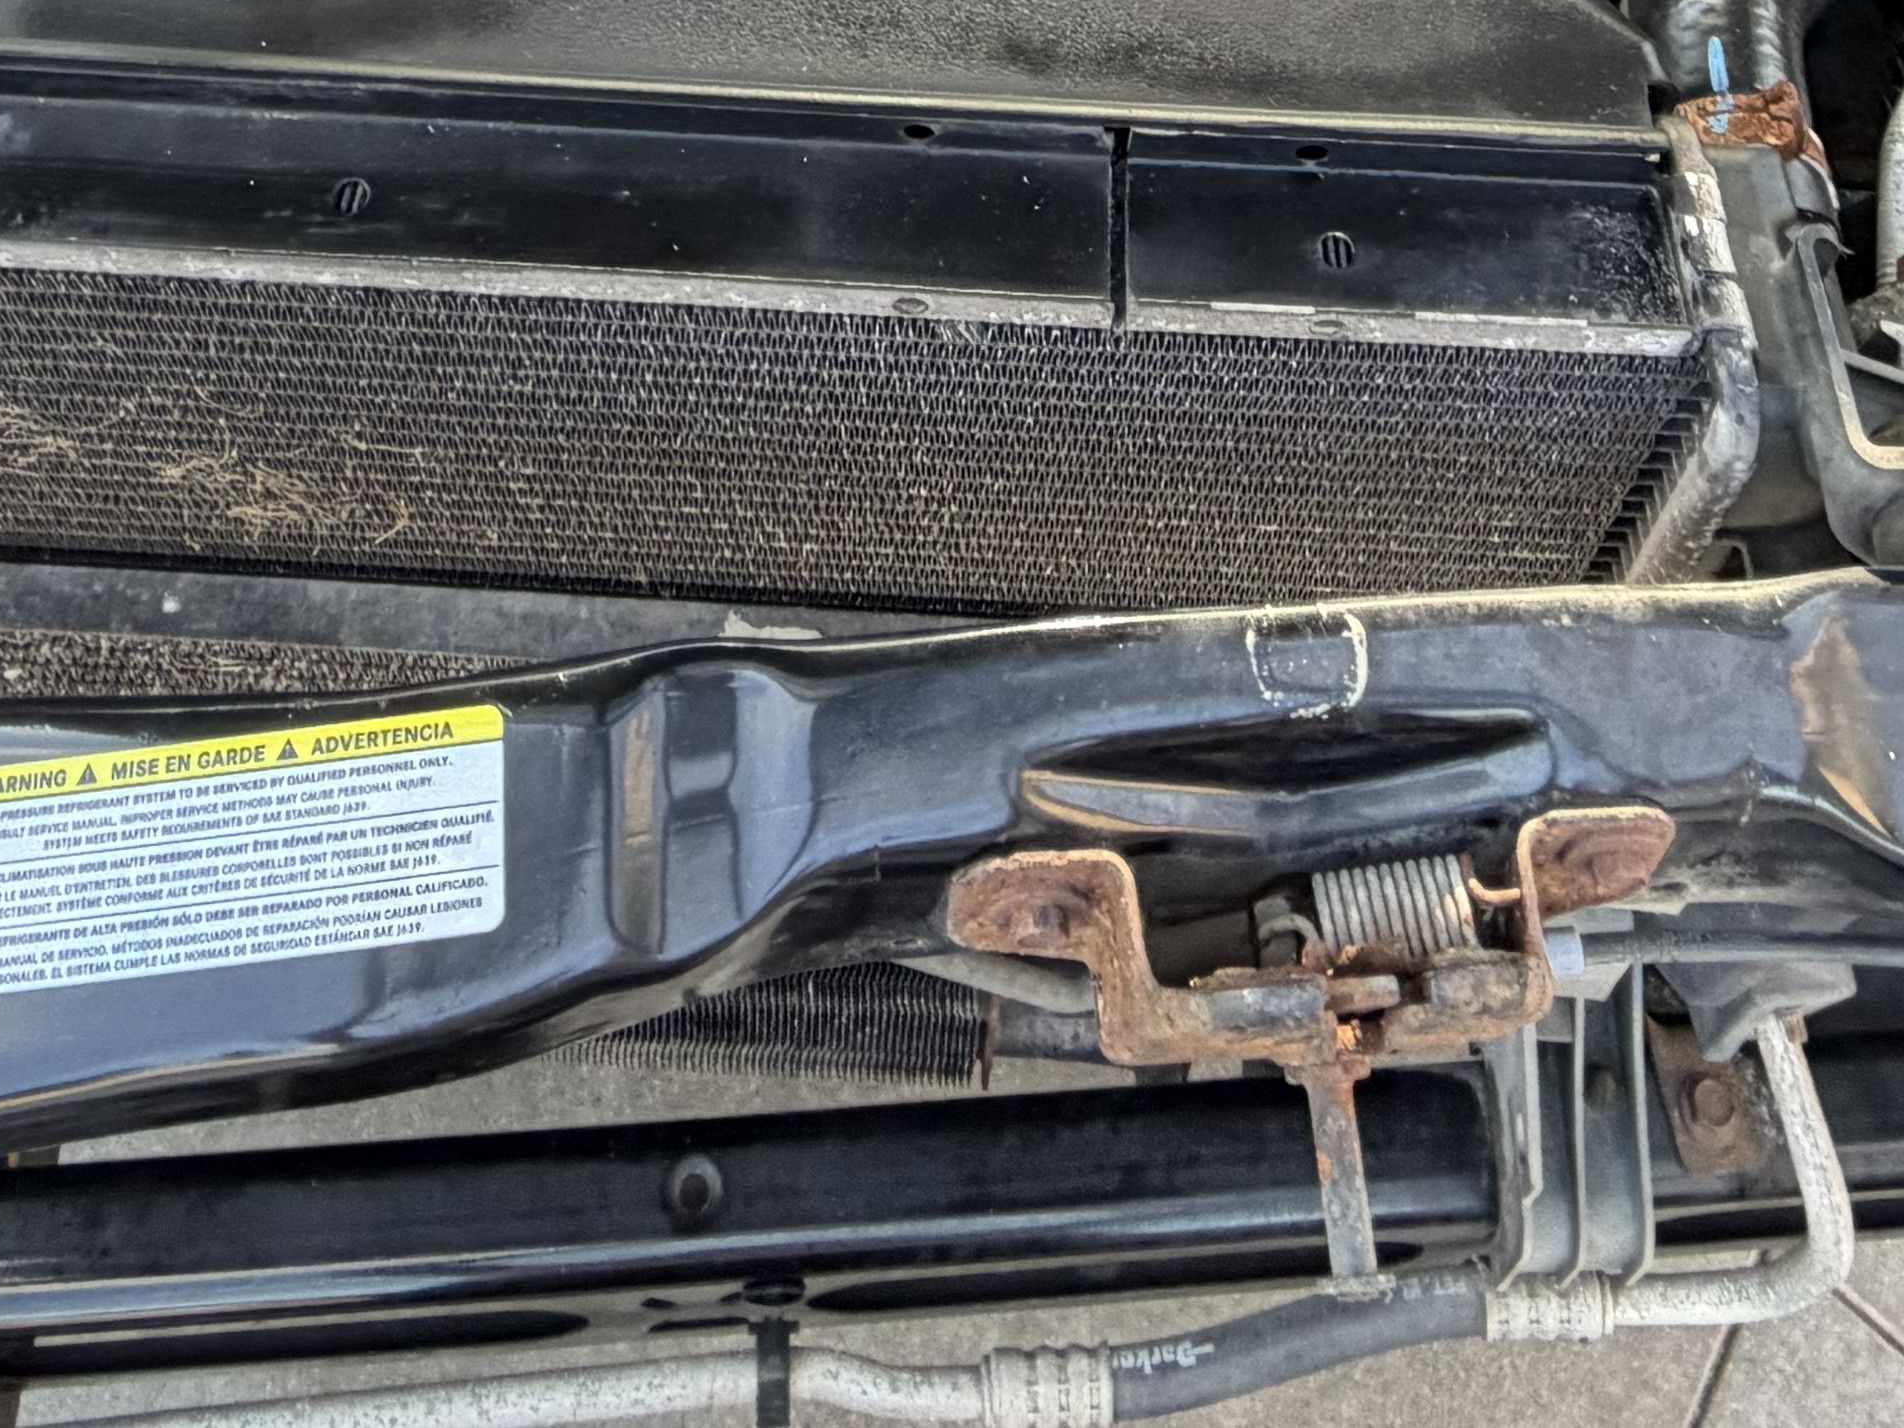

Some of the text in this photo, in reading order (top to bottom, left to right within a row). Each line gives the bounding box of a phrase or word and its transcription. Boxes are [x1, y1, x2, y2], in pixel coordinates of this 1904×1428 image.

[109, 755, 160, 781] MISE
[163, 751, 192, 774] EN
[195, 742, 266, 770] GARDE
[311, 719, 453, 756] ADVERTENCIA
